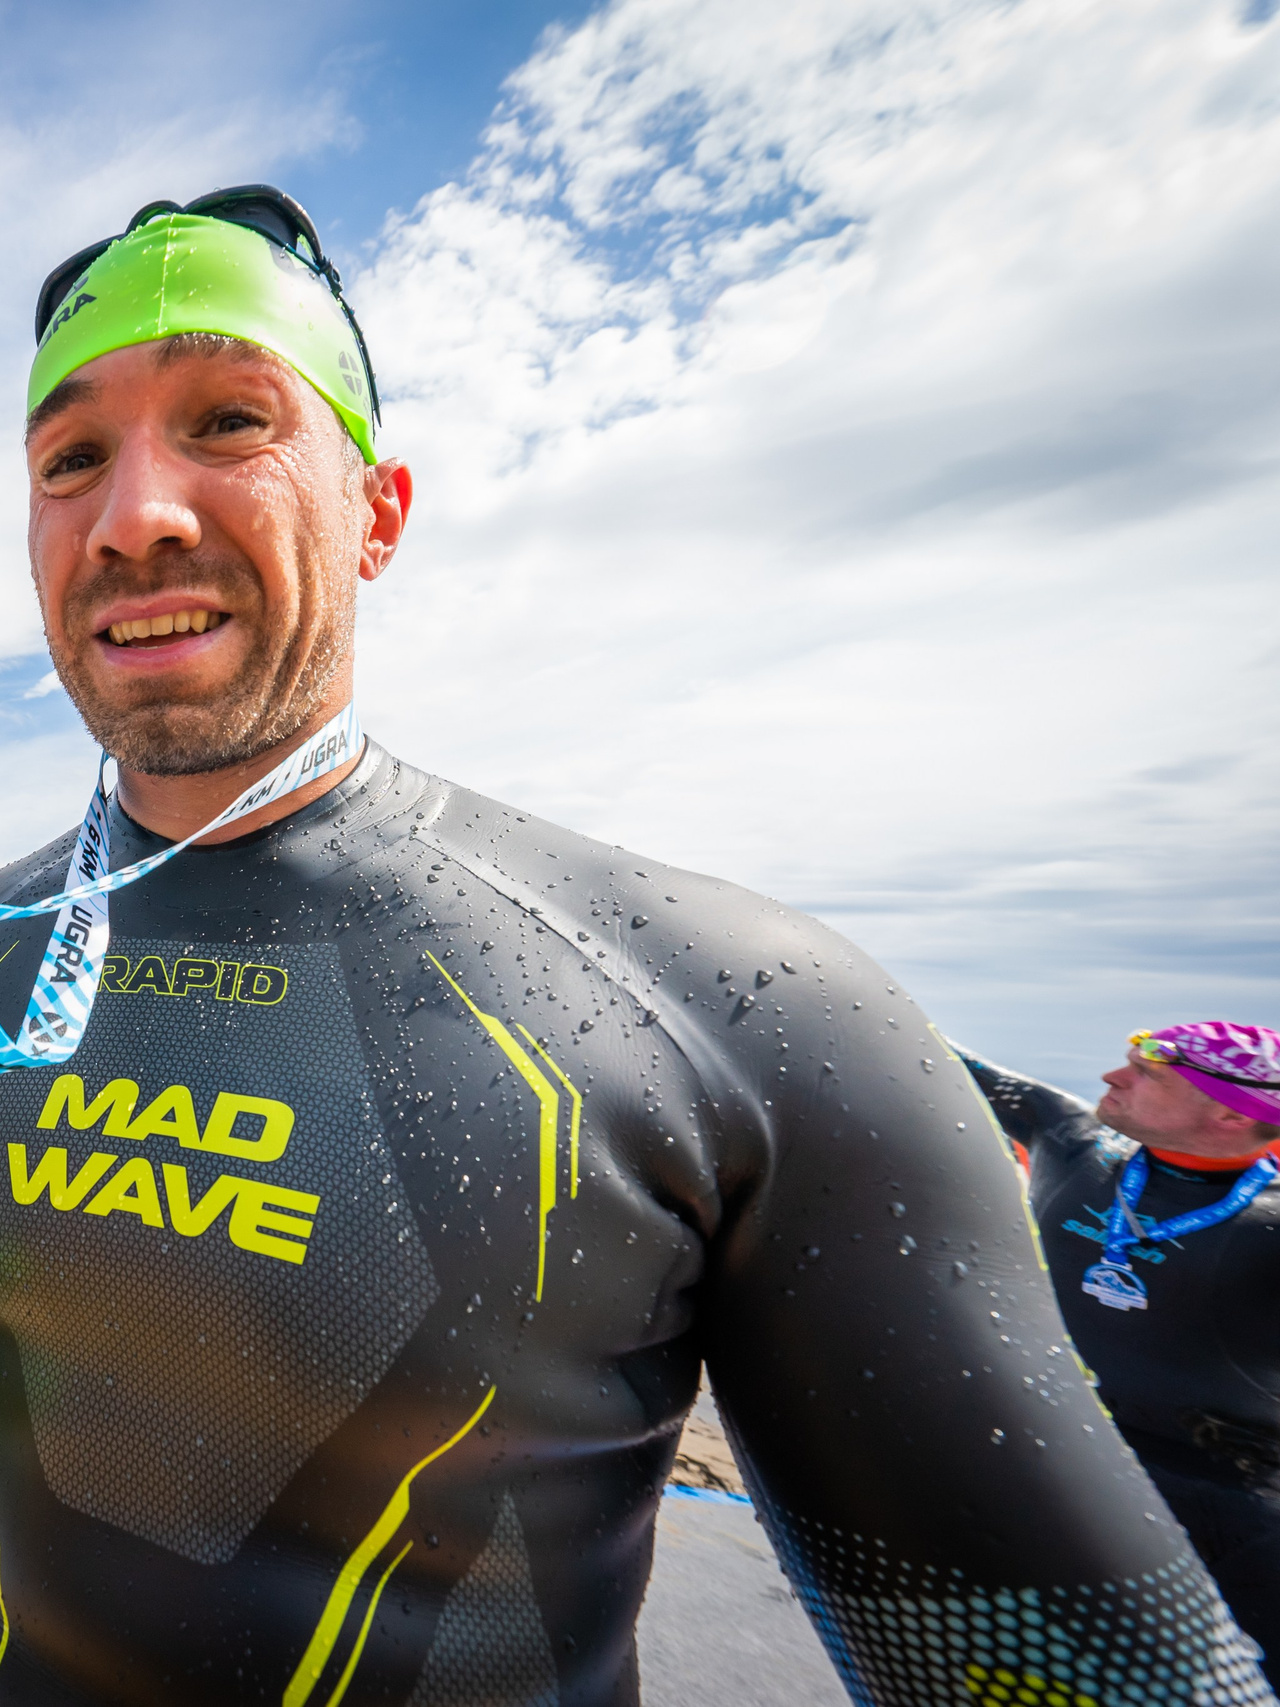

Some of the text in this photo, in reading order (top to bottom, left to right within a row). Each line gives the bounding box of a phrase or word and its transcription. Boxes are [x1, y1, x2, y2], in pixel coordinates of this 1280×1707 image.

[301, 730, 348, 774] UGRA
[50, 824, 101, 983] 6 KM UGRA
[94, 956, 288, 1005] RAPID
[36, 1074, 296, 1162] MAD
[7, 1143, 321, 1266] WAVE
